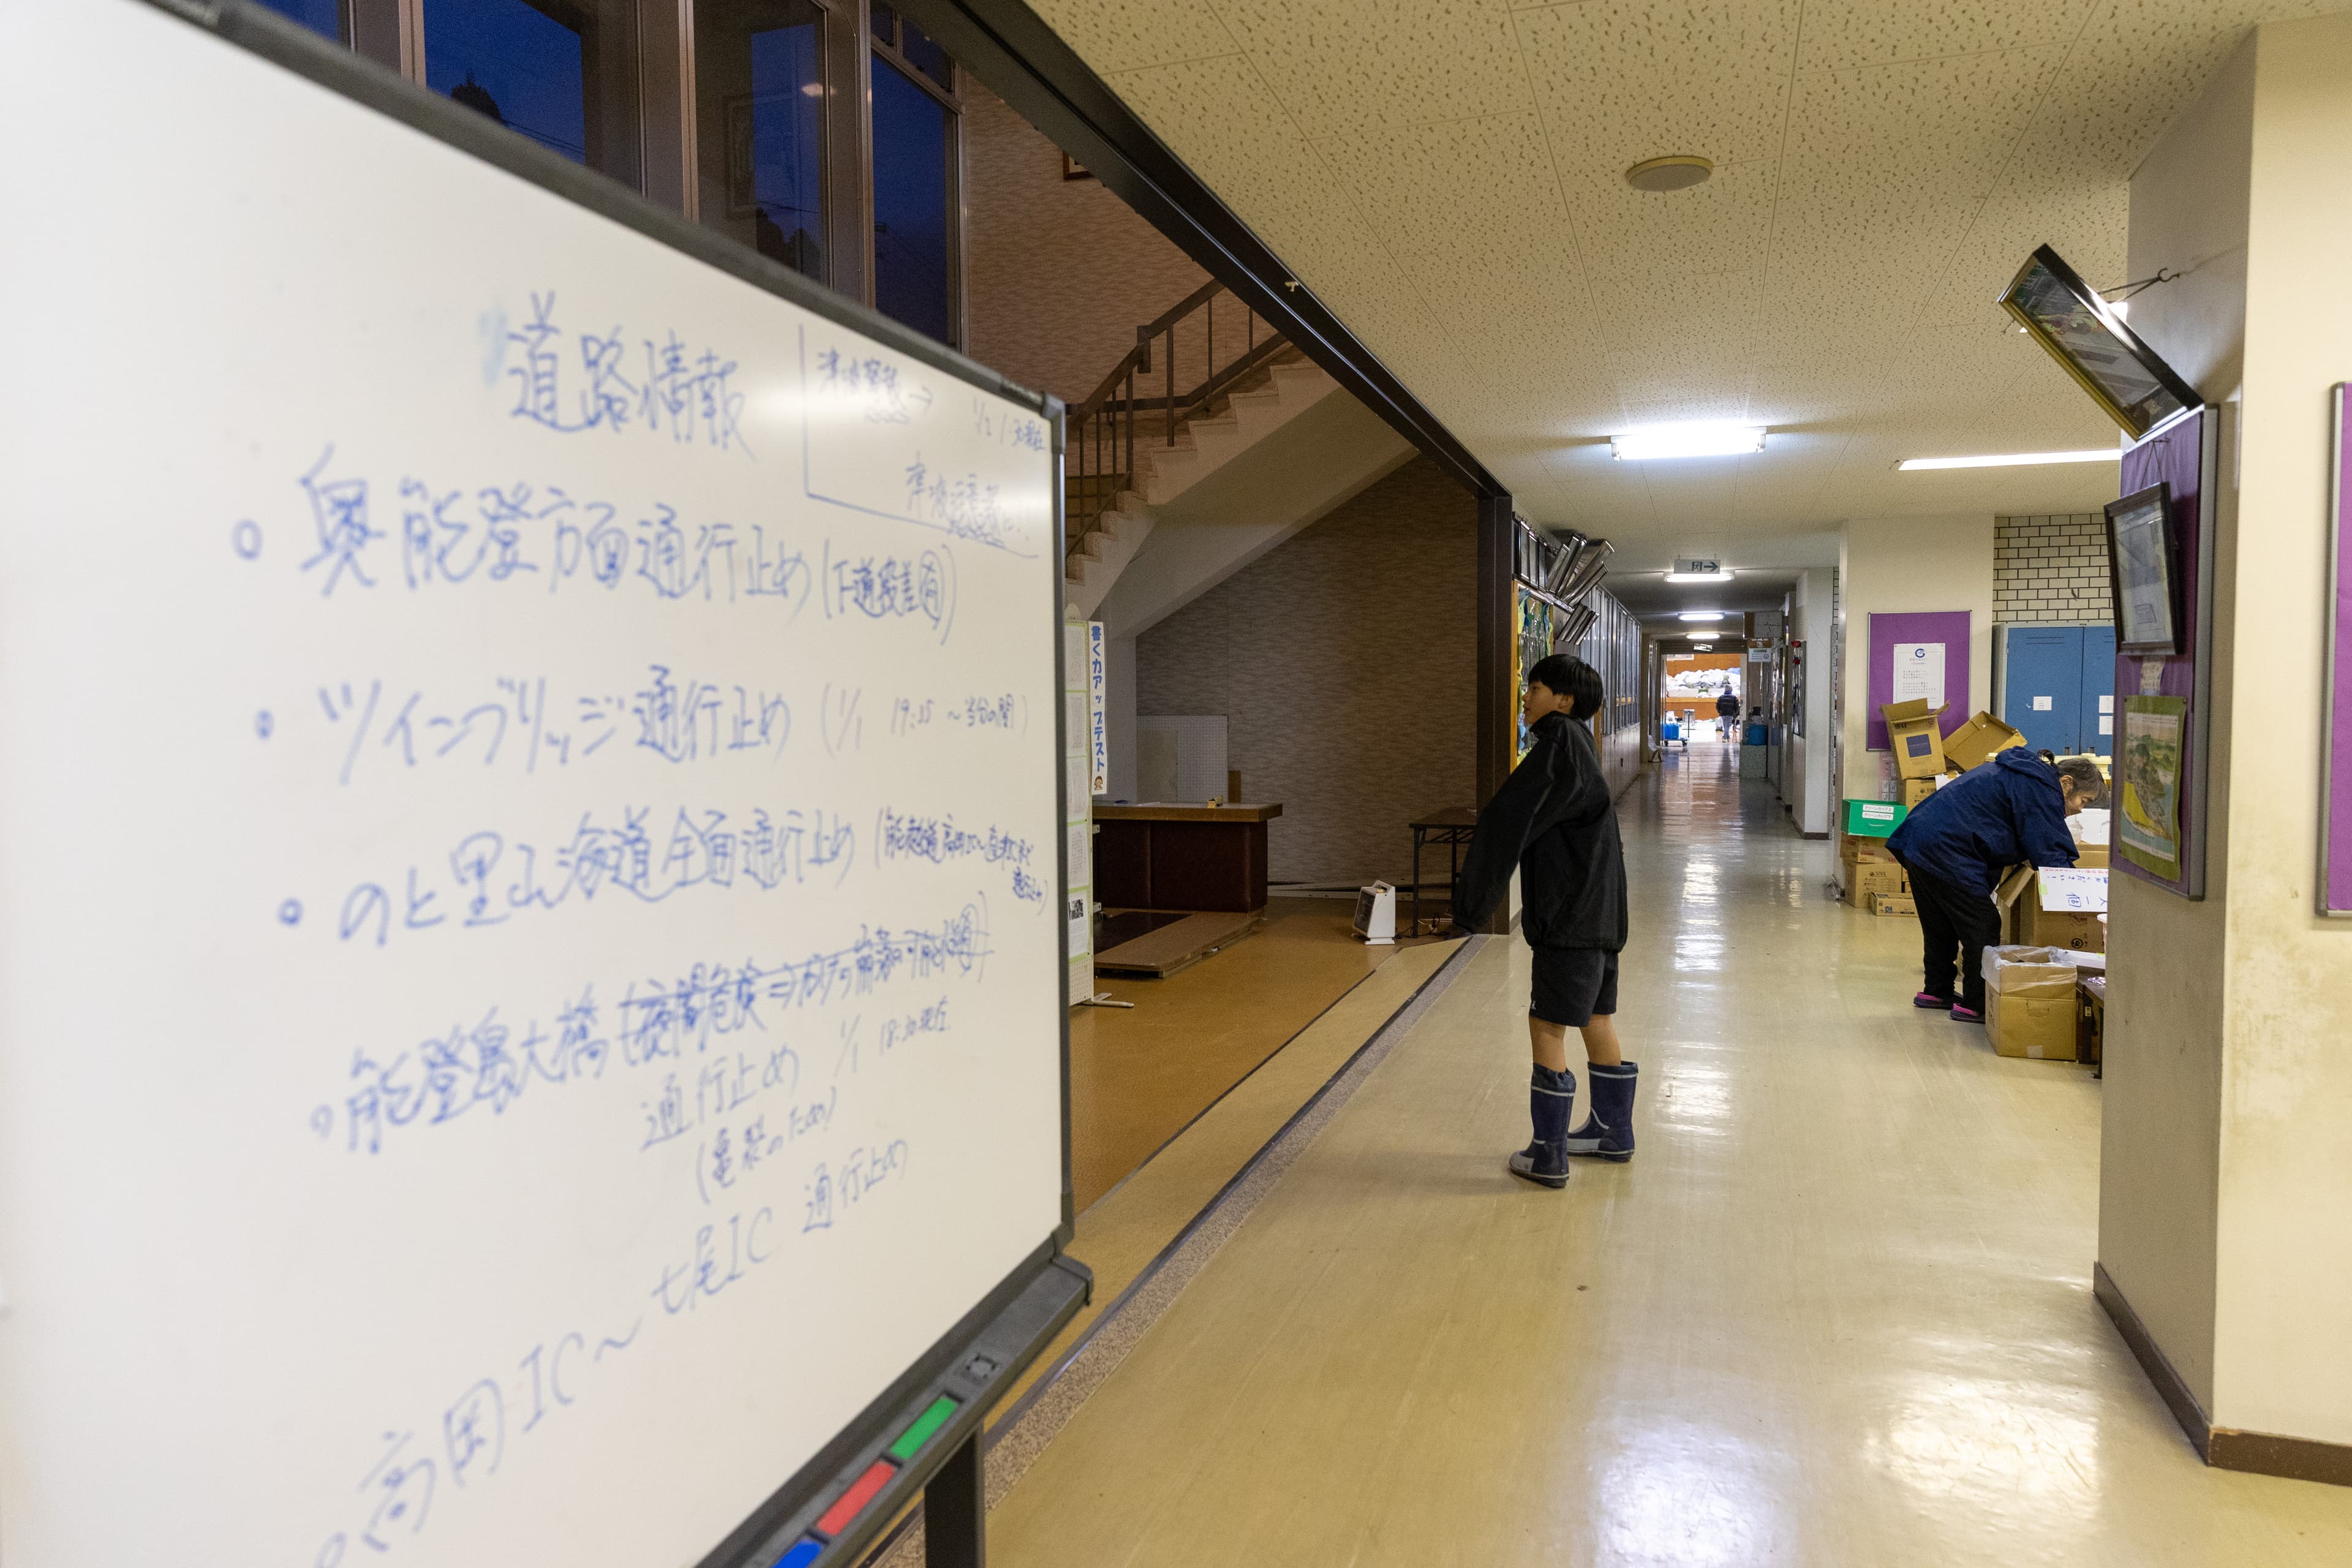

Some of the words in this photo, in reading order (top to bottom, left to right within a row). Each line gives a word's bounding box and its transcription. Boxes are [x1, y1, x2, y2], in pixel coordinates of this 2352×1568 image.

[506, 290, 757, 462] 道路情報
[1091, 625, 1105, 772] 書く力アップテスト
[640, 1044, 800, 1152] 通行止め
